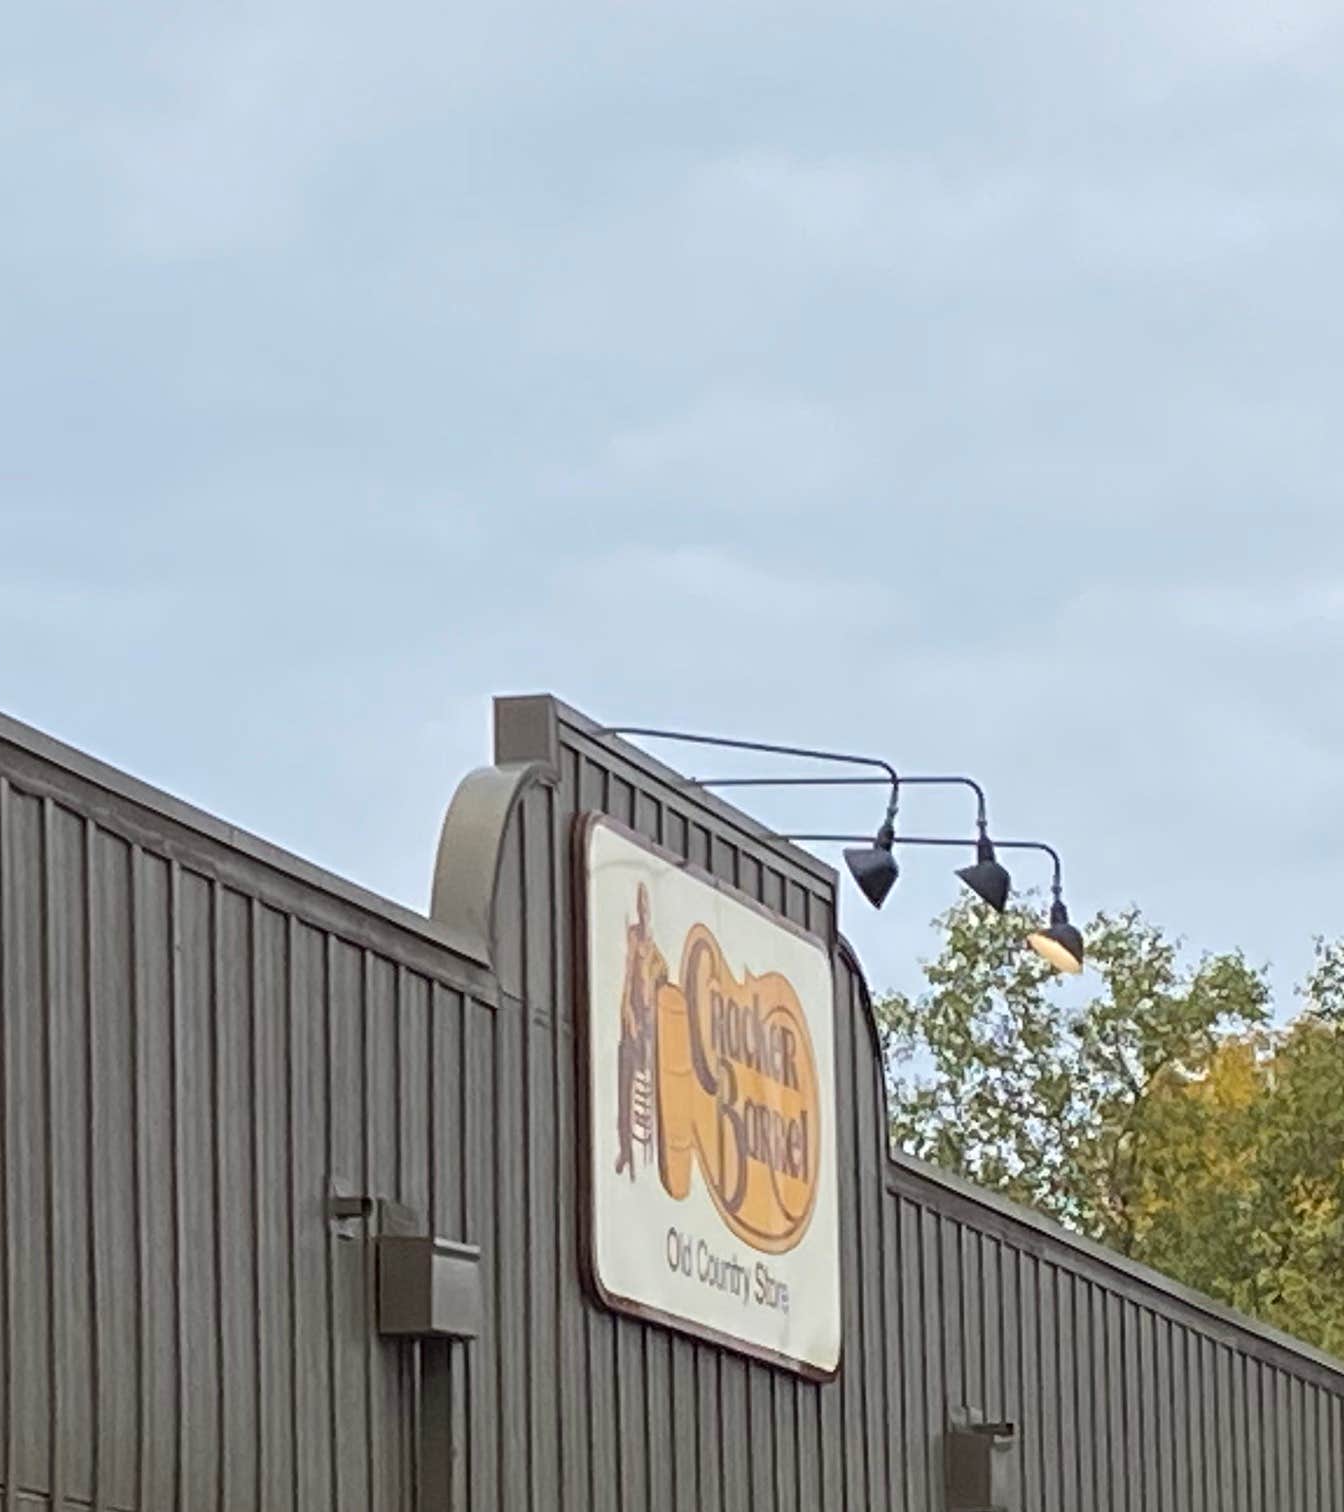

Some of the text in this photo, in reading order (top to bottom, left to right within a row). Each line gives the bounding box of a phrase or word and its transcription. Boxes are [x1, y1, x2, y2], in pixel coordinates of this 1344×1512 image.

[667, 1226, 789, 1314] Old Country Store
